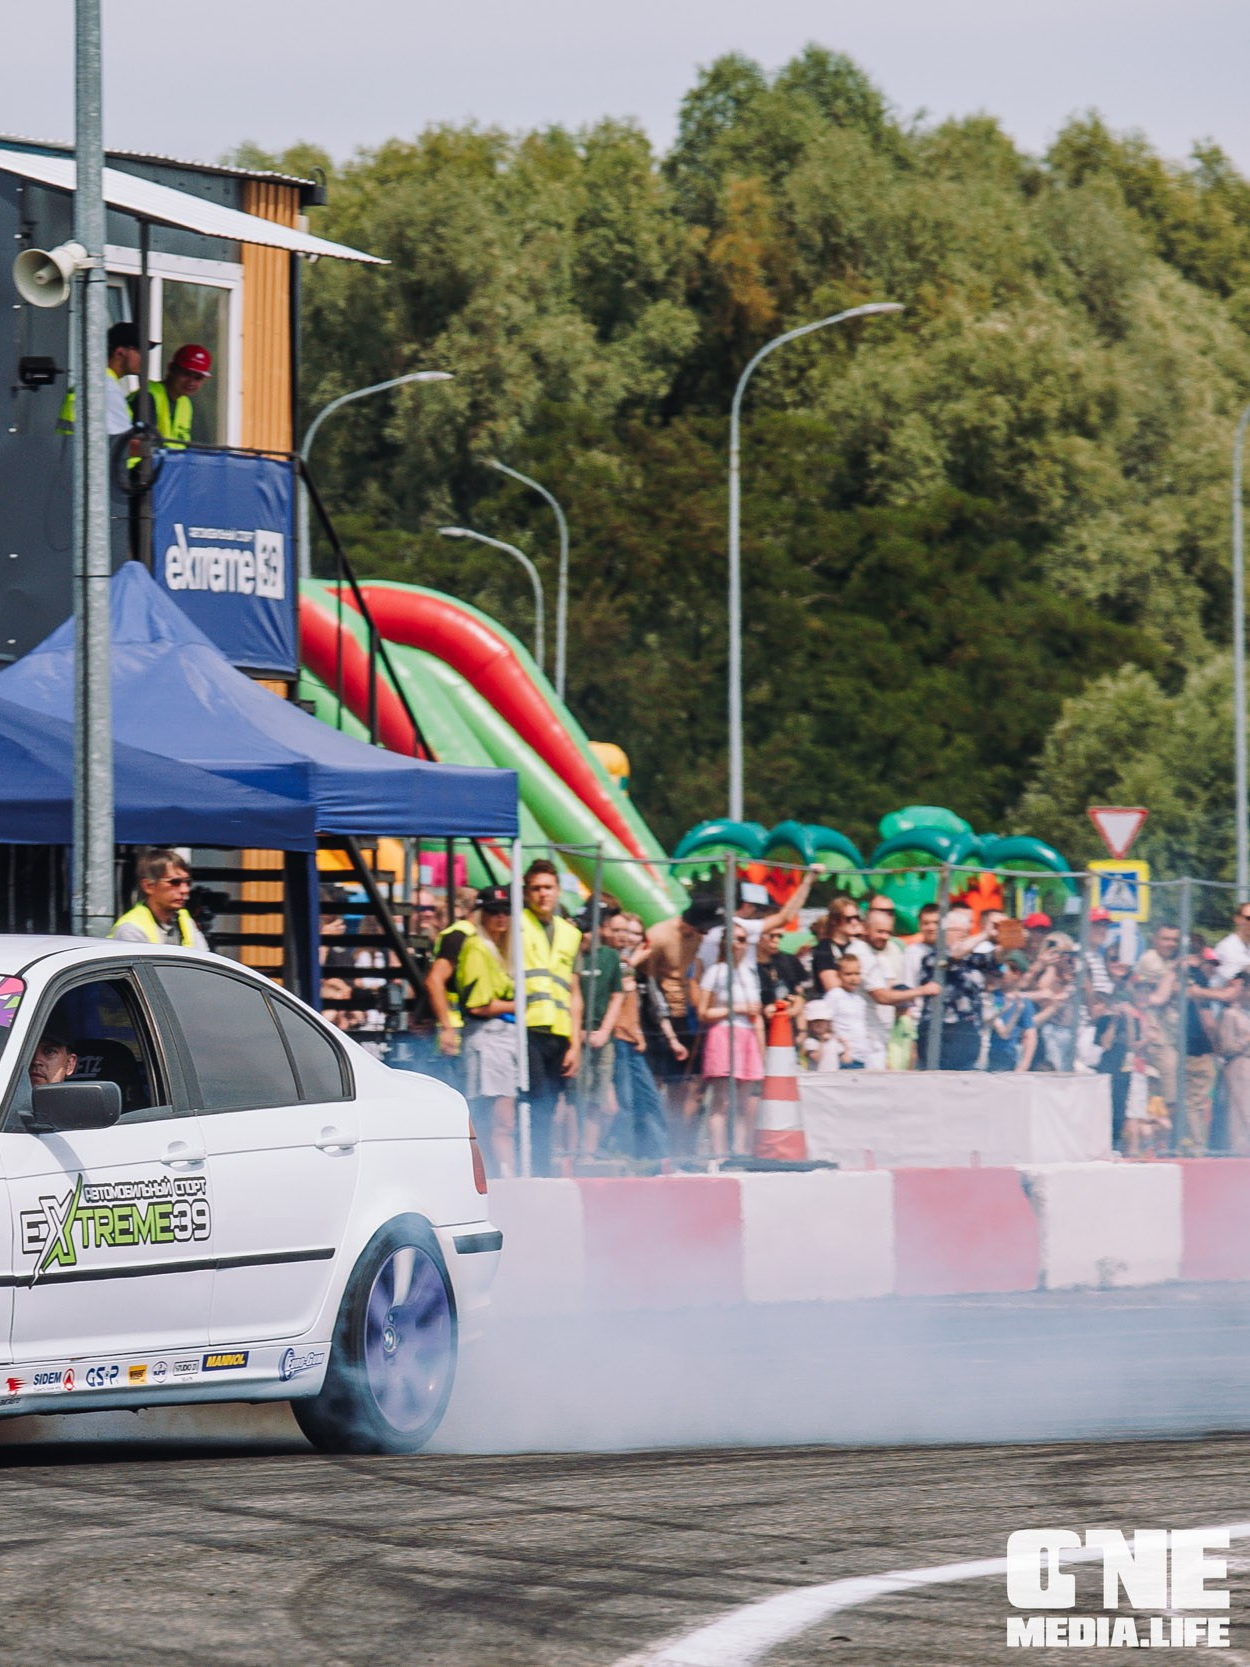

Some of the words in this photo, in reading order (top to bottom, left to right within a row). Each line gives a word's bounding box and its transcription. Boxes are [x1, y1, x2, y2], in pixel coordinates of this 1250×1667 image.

[84, 1177, 173, 1202] АВТОМОБИЛЬНЫЙ
[173, 1177, 206, 1195] СПОРТ
[33, 1371, 63, 1386] SIDEM
